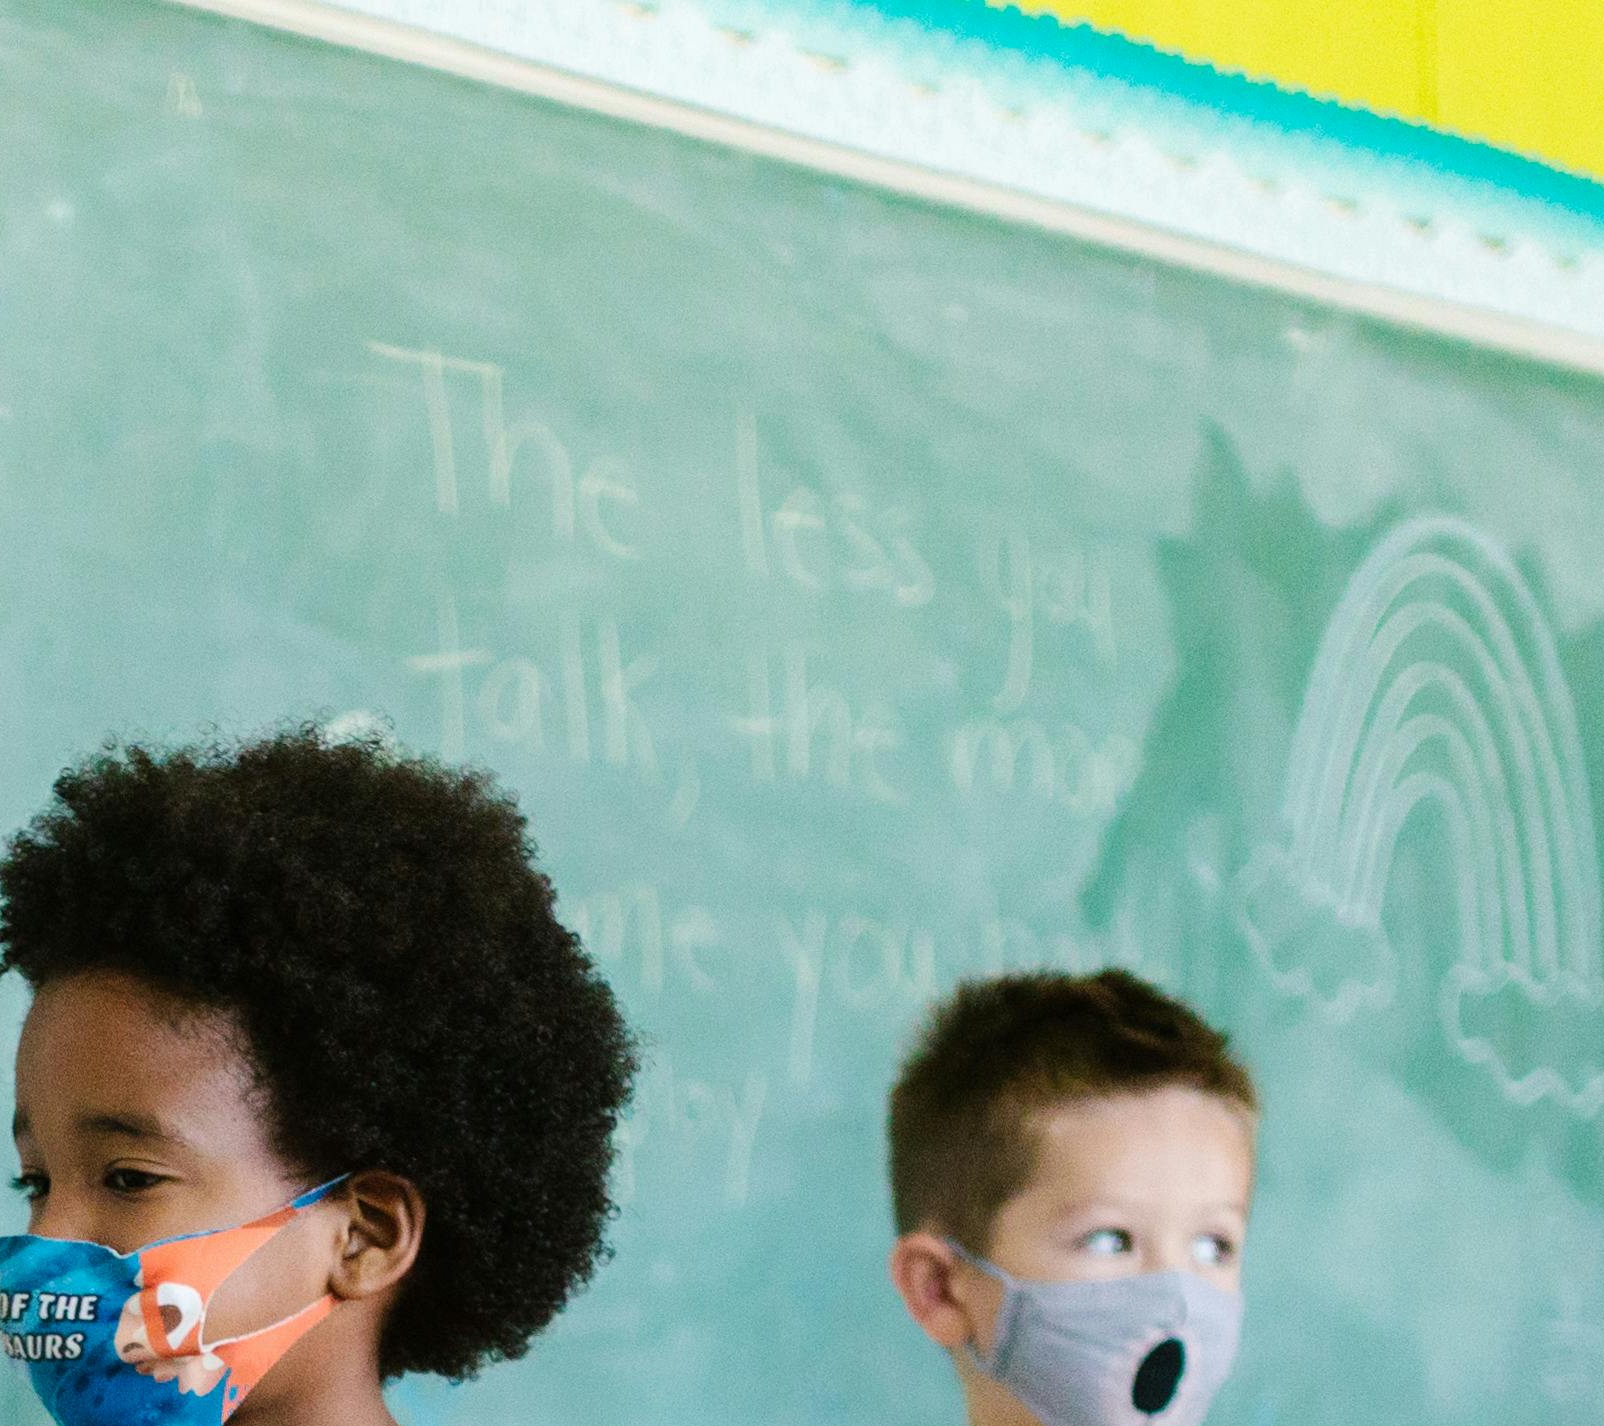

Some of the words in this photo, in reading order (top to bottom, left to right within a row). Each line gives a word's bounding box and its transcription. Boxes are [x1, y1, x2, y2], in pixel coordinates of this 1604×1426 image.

[365, 338, 644, 562] The
[733, 400, 935, 606] less
[37, 1292, 99, 1321] THE
